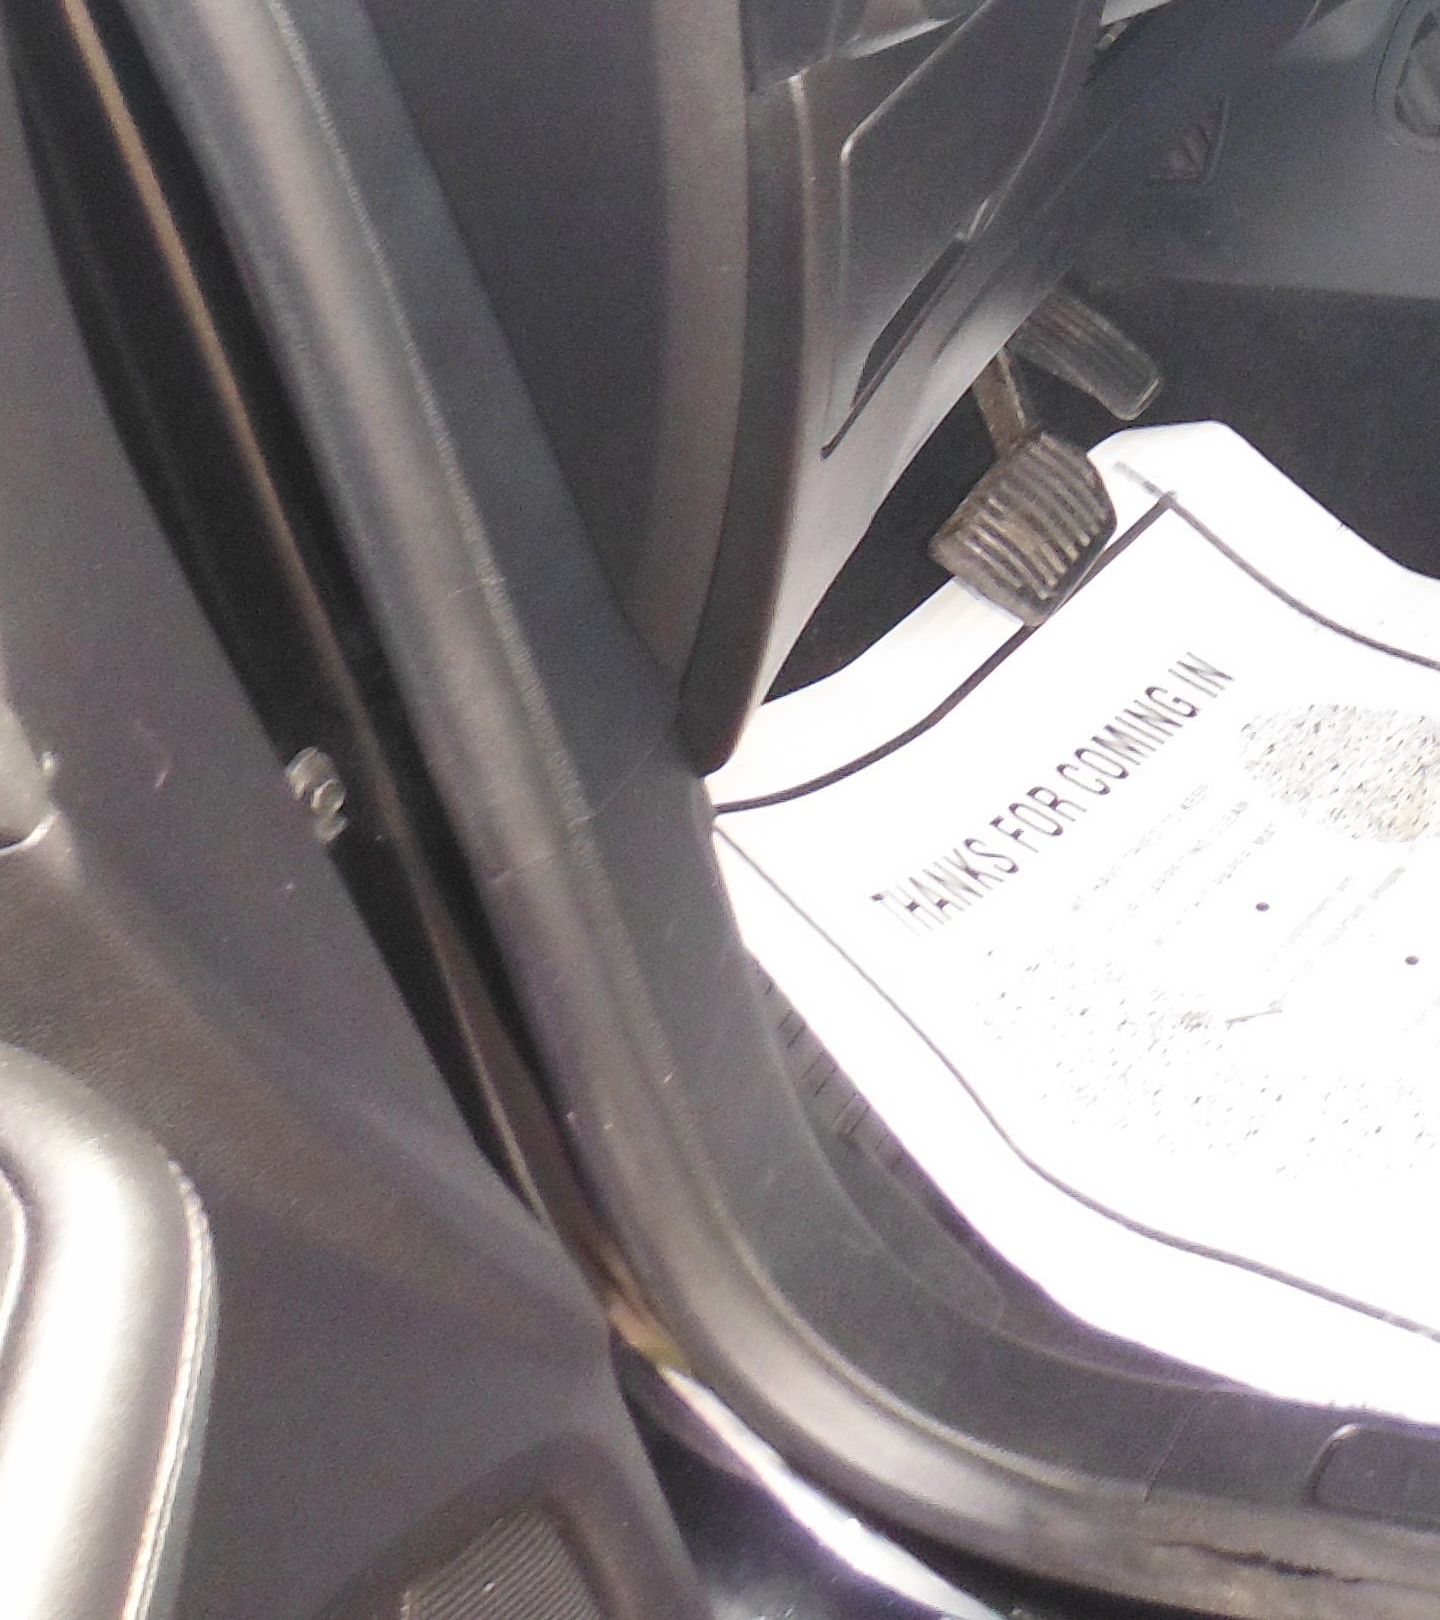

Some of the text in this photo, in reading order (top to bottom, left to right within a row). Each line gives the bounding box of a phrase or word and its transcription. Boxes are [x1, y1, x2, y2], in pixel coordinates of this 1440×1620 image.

[870, 837, 1020, 937] THANKS
[989, 785, 1087, 854] FOR
[1056, 685, 1201, 795] COMING
[1168, 651, 1235, 698] IN
